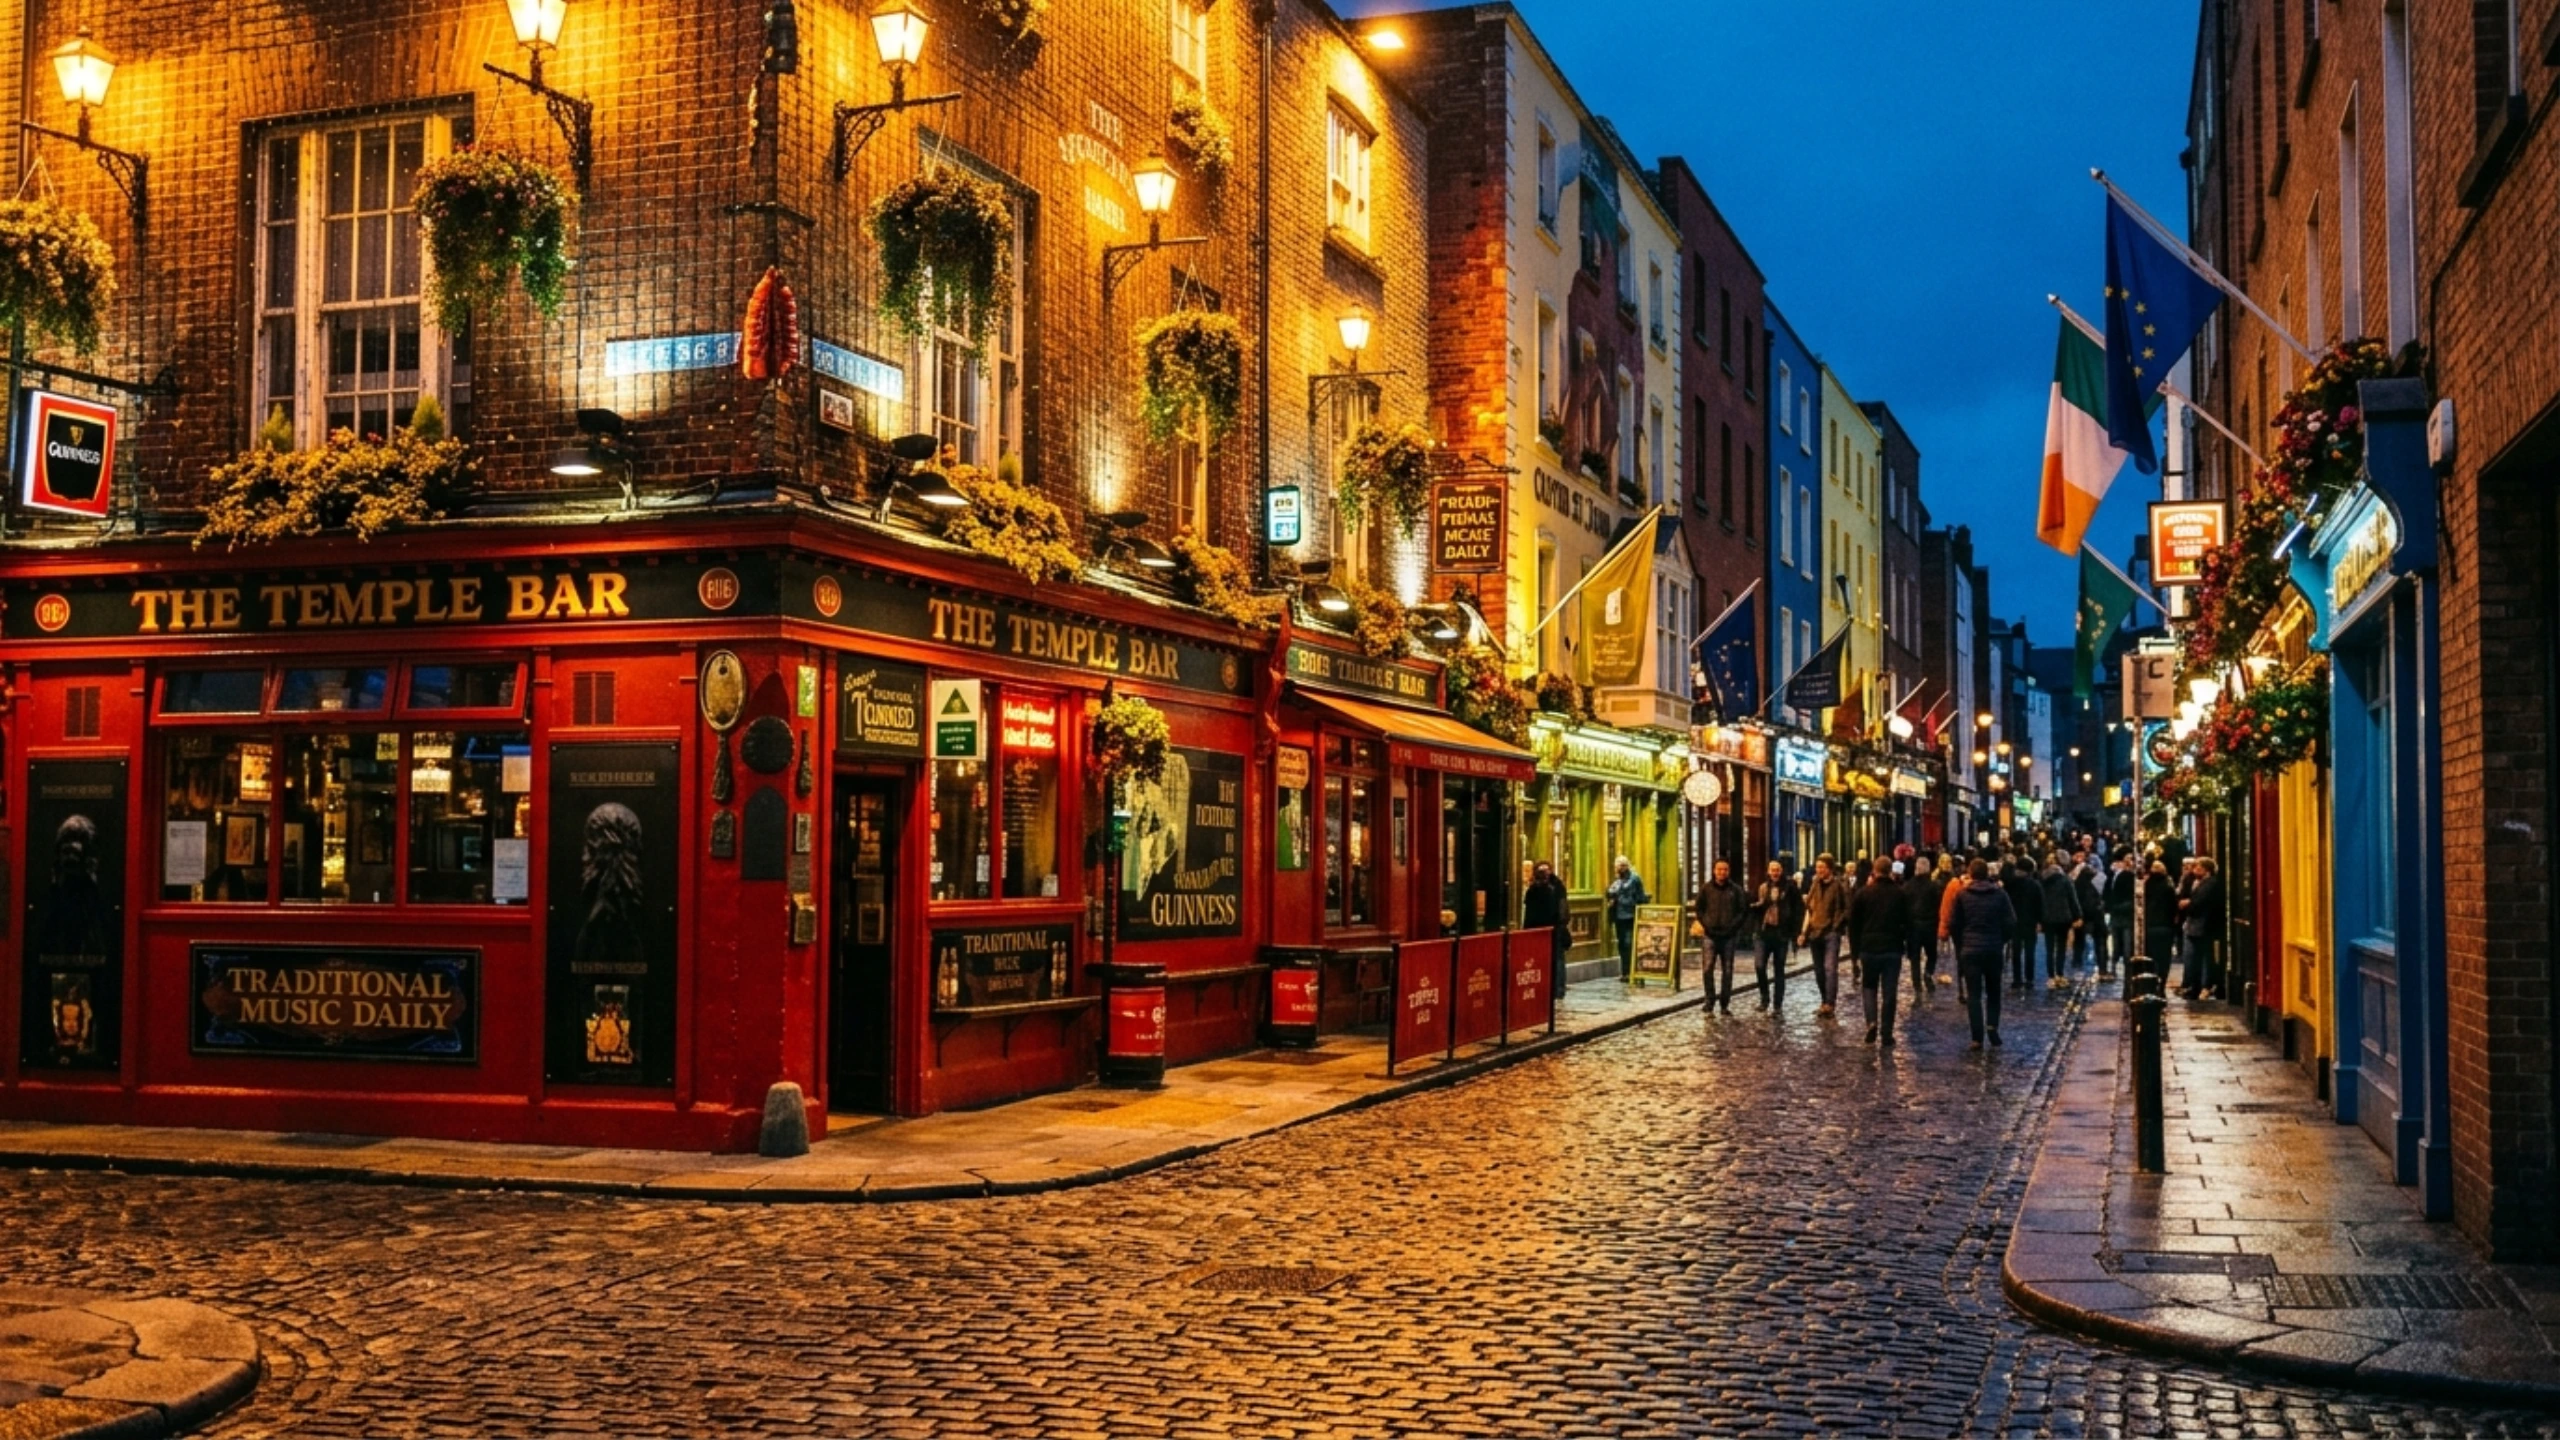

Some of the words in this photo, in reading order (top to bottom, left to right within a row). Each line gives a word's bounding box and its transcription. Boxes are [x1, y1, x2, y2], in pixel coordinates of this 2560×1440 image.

[131, 587, 241, 632] THE
[259, 577, 482, 626] TEMPLE
[506, 572, 629, 621] BAR
[928, 598, 996, 648] THE
[1007, 614, 1119, 669] TEMPLE
[1128, 638, 1180, 680] BAR
[1151, 892, 1236, 926] GUINNESS
[227, 968, 451, 998] TRADITIONAL
[238, 998, 341, 1025] MUSIC
[352, 1001, 451, 1030] DAILY
